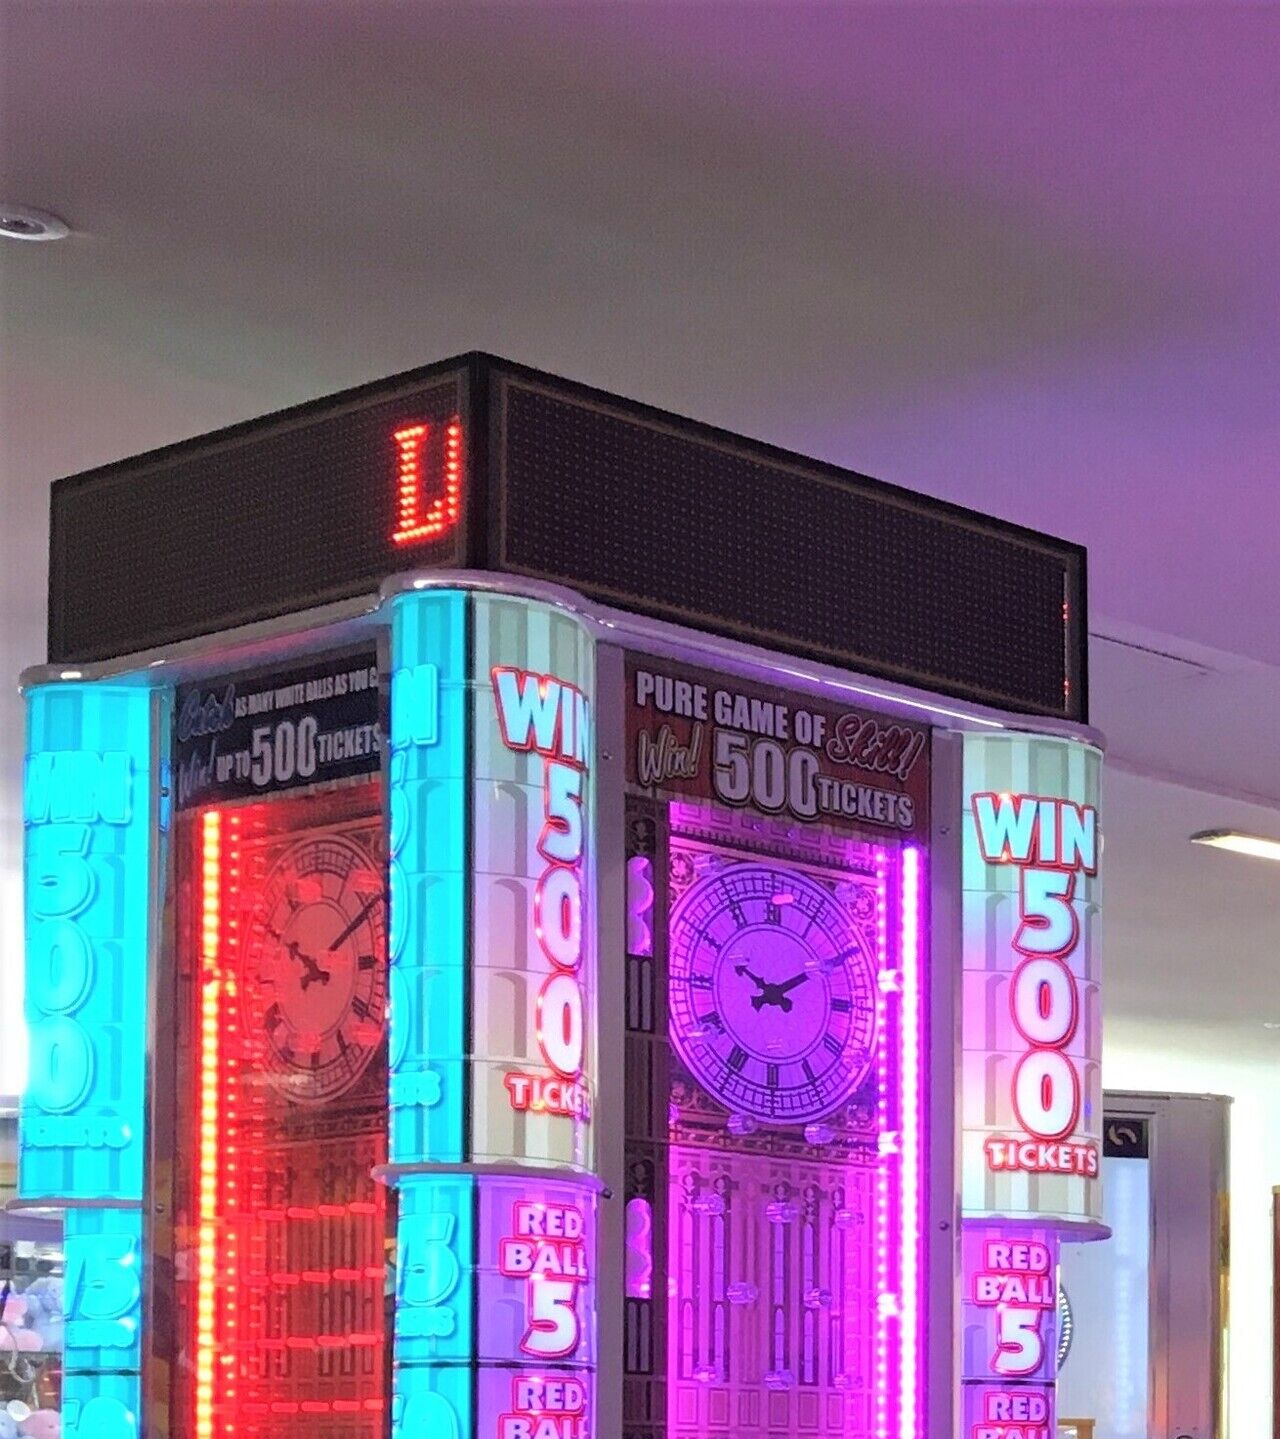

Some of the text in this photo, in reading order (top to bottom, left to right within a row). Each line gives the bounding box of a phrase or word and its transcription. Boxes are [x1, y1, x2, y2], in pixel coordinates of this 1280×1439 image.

[251, 716, 317, 786] 500
[316, 723, 382, 763] TICKETS
[636, 671, 925, 781] PURE GAME OF Skill!
[638, 721, 914, 829] Win! 500 TICKETS
[972, 793, 1098, 875] WIN
[1011, 866, 1079, 1139] 500
[986, 1139, 1098, 1176] TICKETS
[516, 1202, 584, 1238] RED
[502, 1239, 588, 1277] BALL
[985, 1240, 1050, 1272] RED
[974, 1273, 1053, 1305] BALL
[522, 1279, 580, 1357] 5
[990, 1306, 1043, 1374] 5
[515, 1378, 585, 1413] RED
[985, 1391, 1048, 1423] RED
